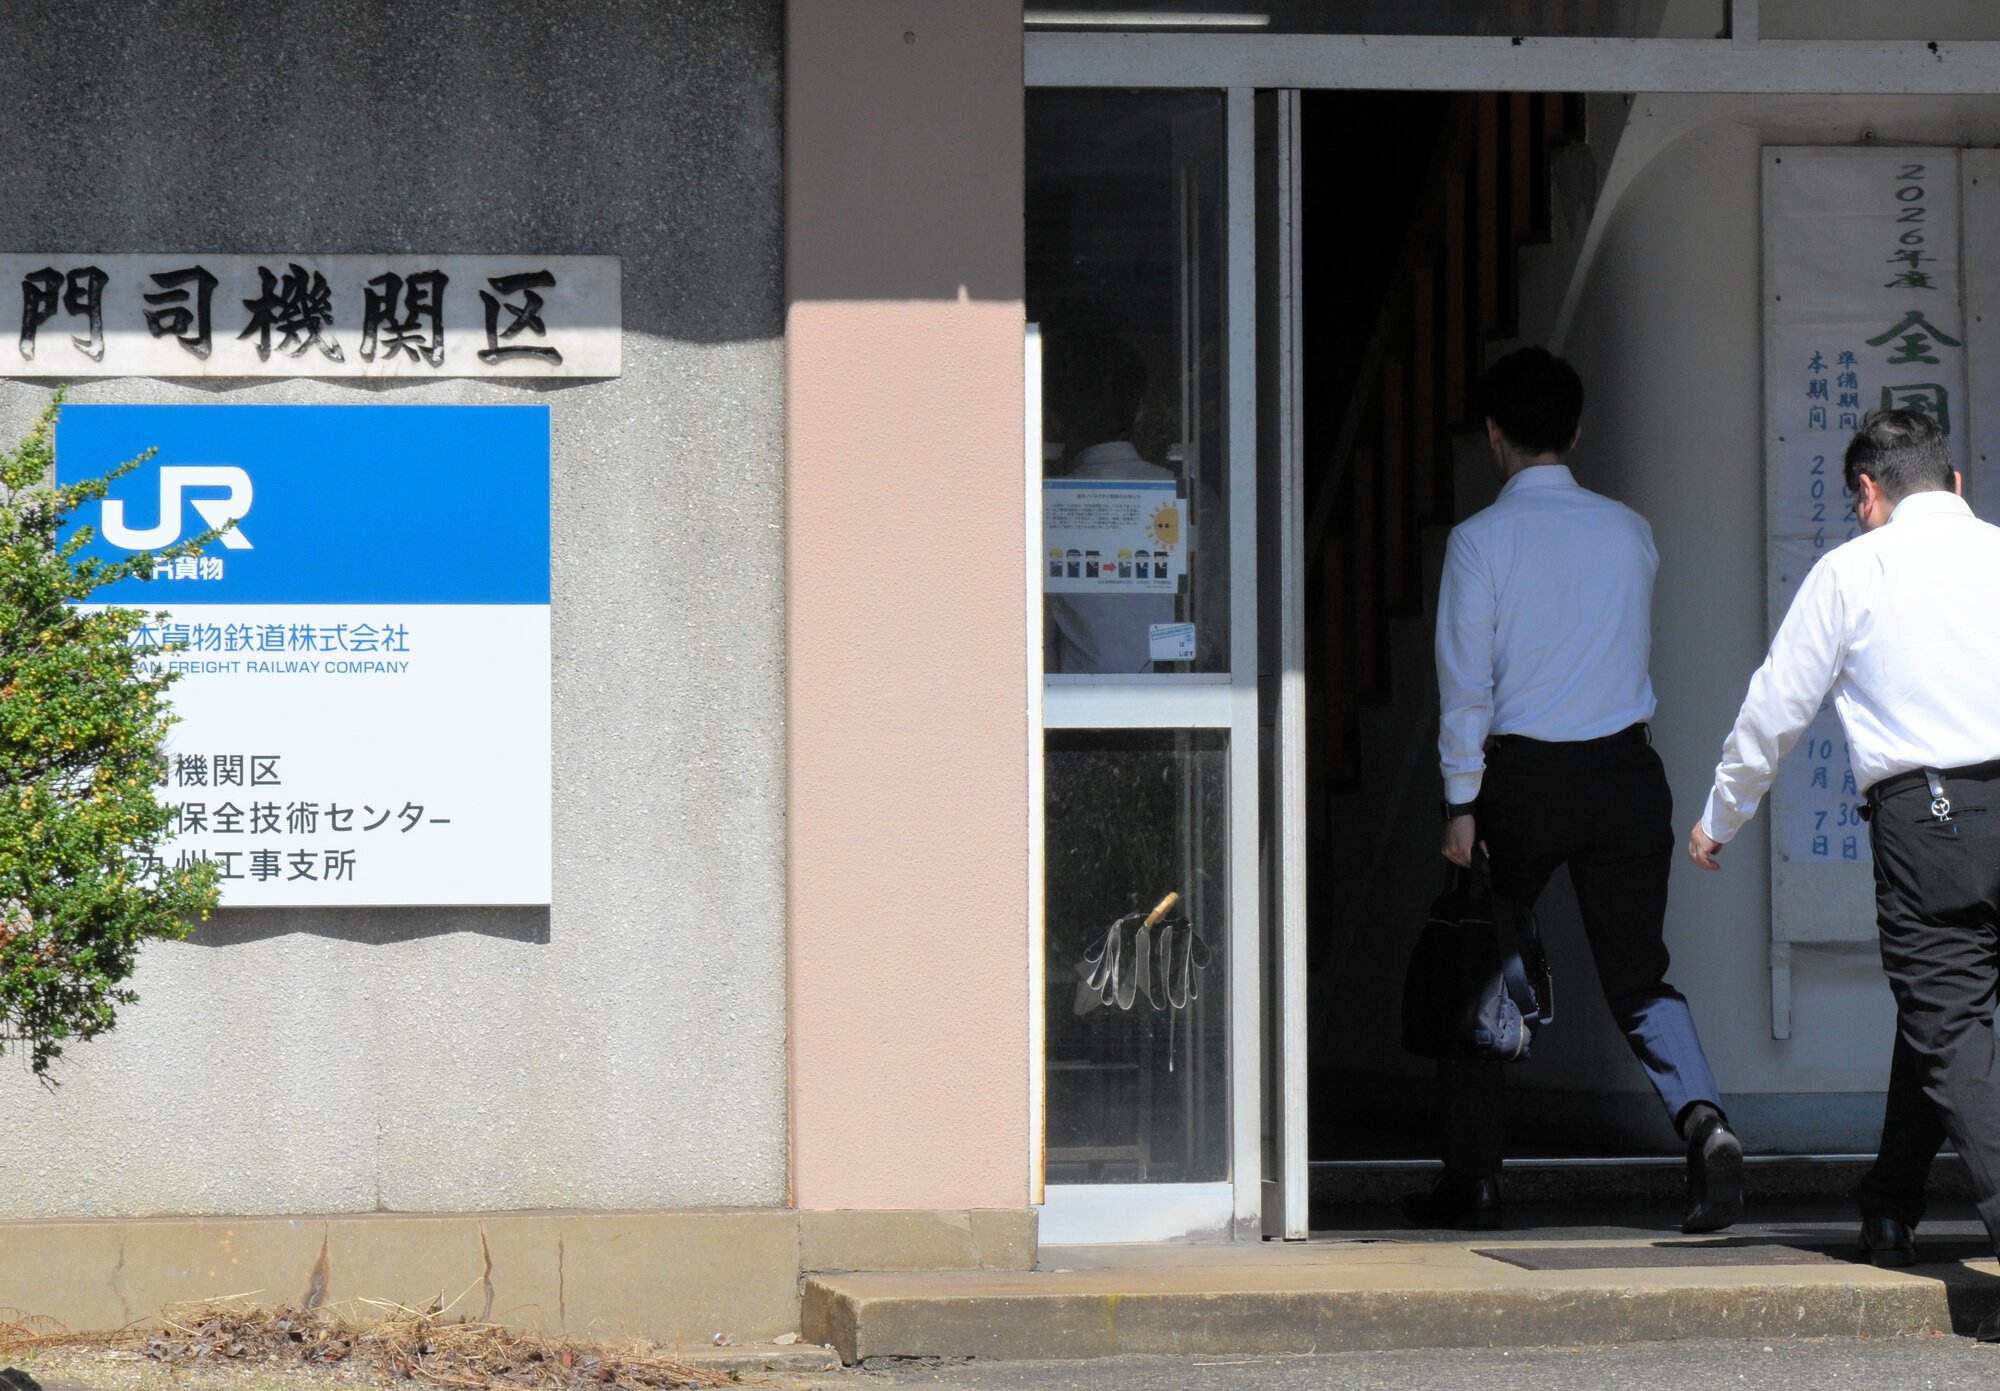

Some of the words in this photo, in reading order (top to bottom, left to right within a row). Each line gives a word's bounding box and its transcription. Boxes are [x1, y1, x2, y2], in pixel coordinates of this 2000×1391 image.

[1884, 163, 1938, 290] 2026年度
[18, 262, 563, 368] 門司機関区
[101, 466, 254, 549] JR
[132, 556, 223, 580] R貨物
[125, 623, 410, 652] 本貨物鉄道株式会社
[169, 661, 241, 674] FREIGHT
[246, 661, 320, 674] RAILWAY
[324, 661, 409, 674] COMPANY
[156, 754, 281, 787] 機関区
[164, 801, 451, 834] 保全技術センター
